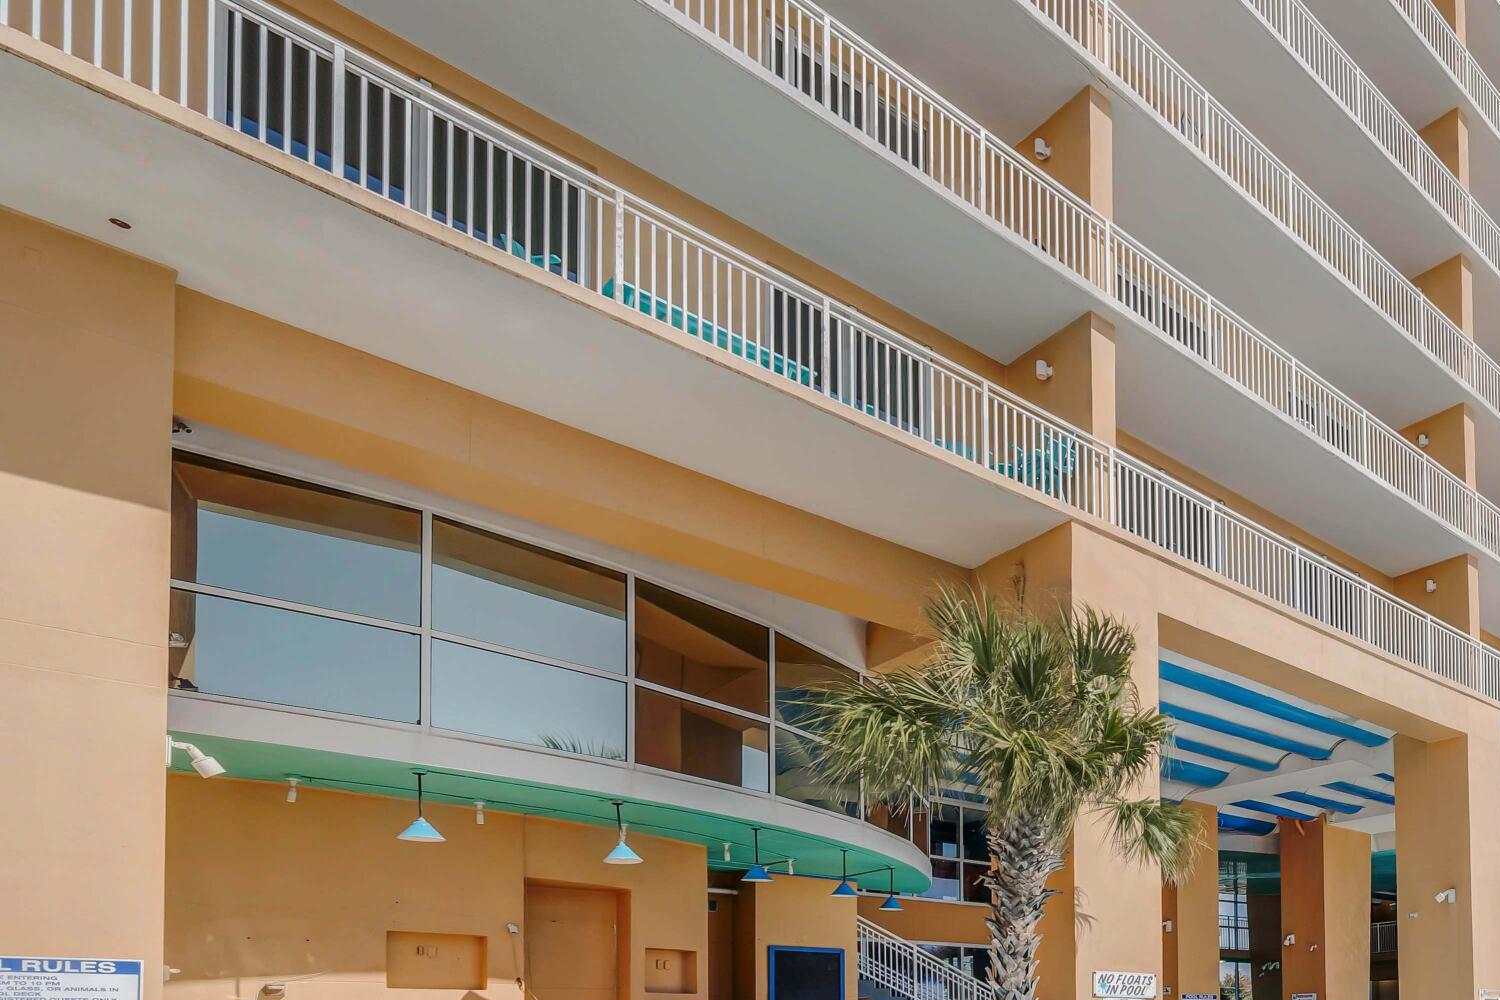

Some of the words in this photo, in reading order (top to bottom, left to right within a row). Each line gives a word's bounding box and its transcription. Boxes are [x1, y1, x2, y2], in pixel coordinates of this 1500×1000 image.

[21, 959, 117, 974] RULES
[1097, 973, 1115, 985] NO
[1116, 974, 1154, 987] FLOATS
[1105, 984, 1118, 996] IN
[1120, 985, 1147, 997] POOL
